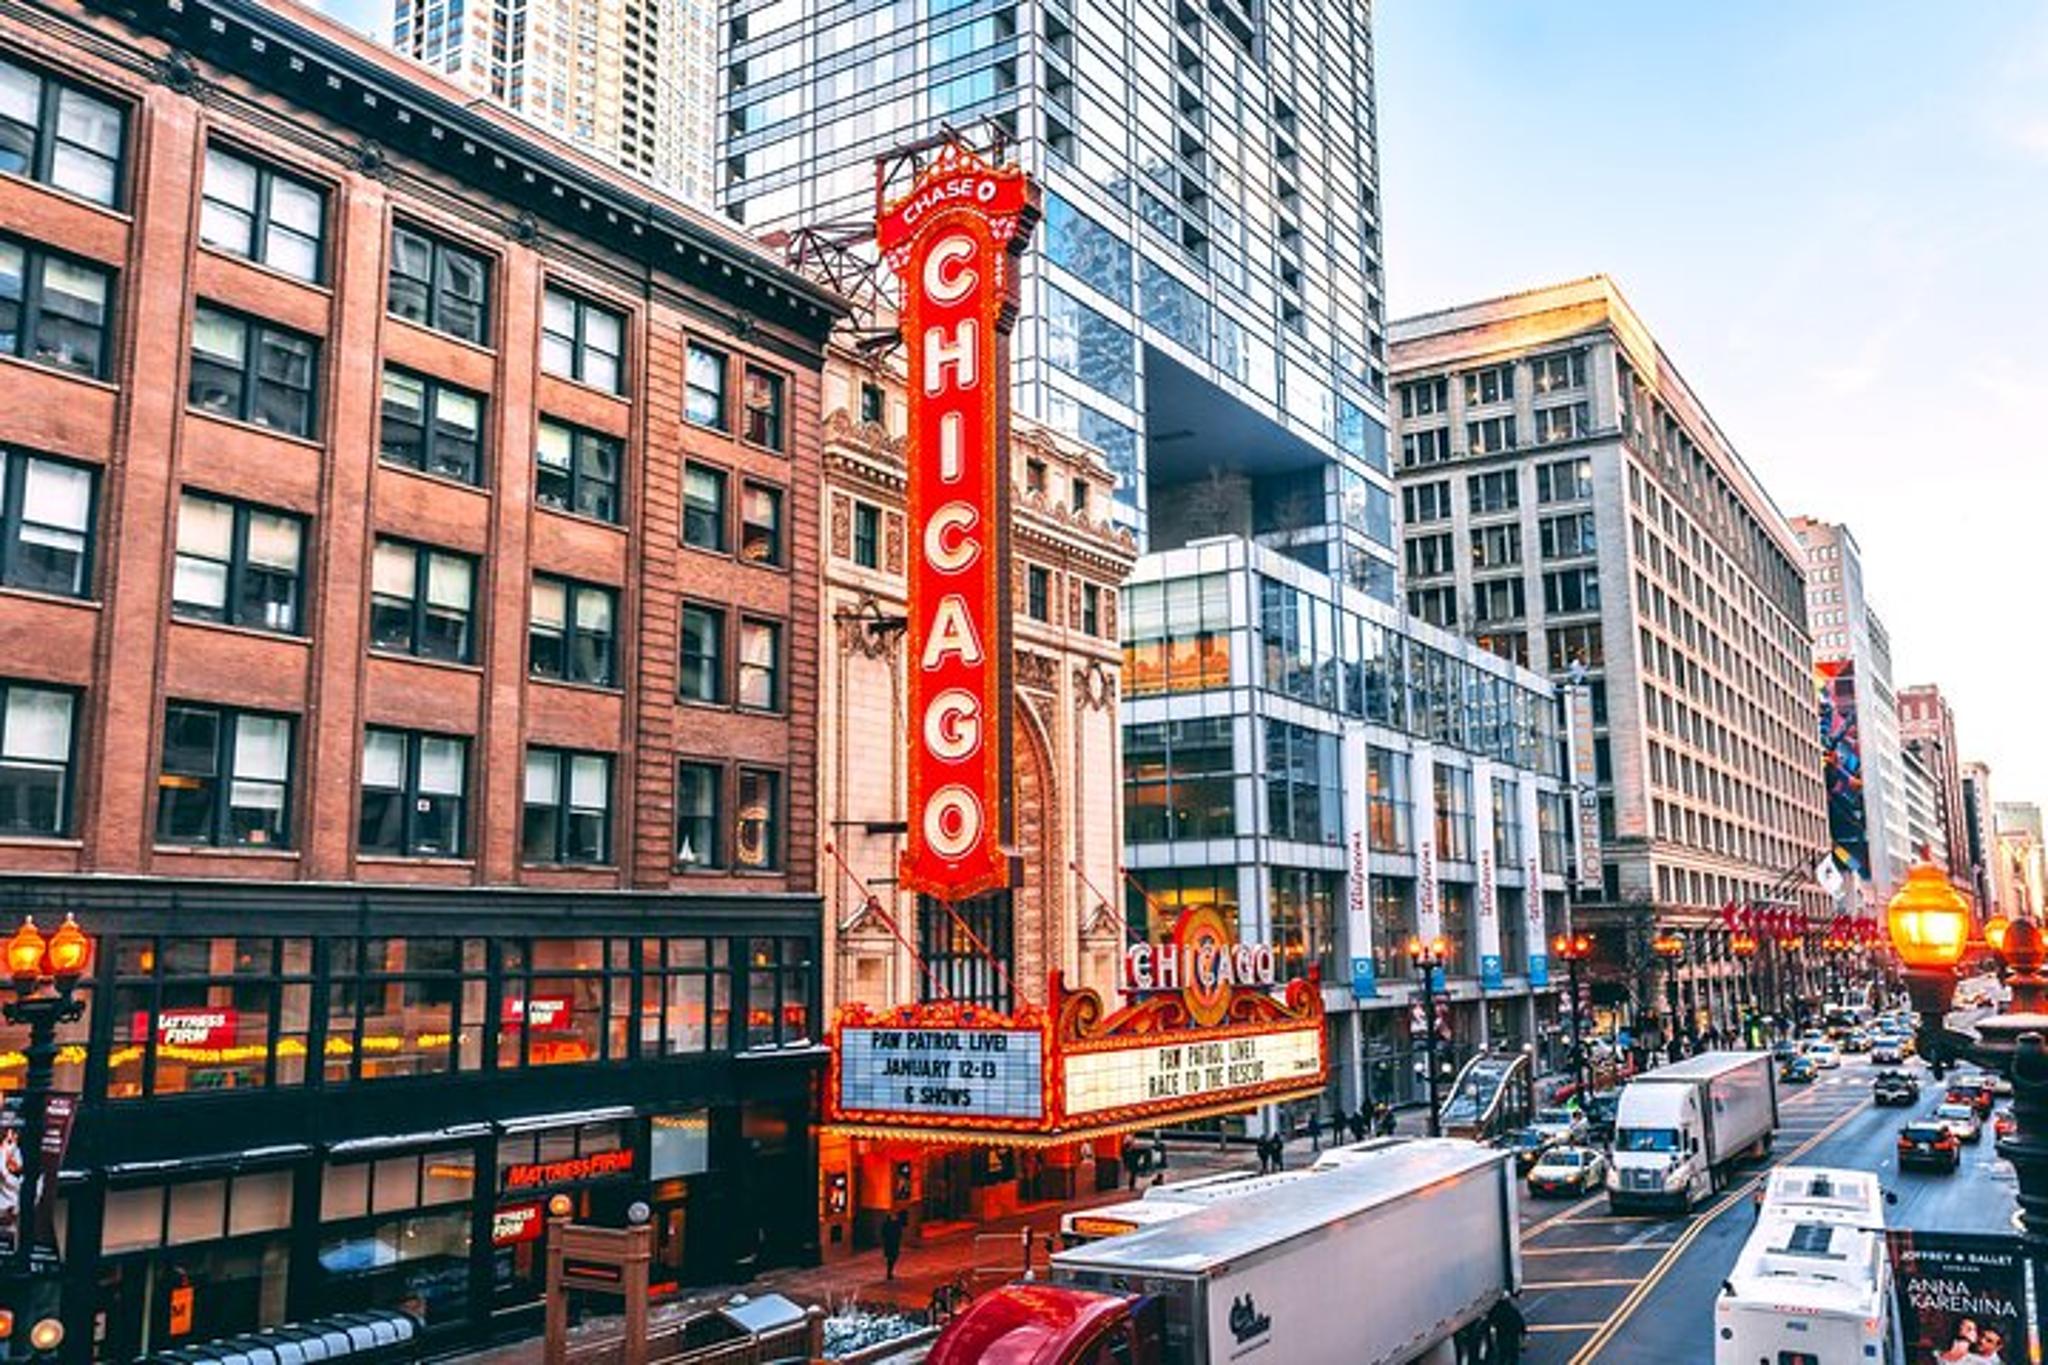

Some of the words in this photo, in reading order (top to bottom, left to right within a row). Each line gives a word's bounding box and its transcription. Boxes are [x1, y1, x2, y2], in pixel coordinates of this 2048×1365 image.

[902, 179, 974, 225] CHASE
[922, 234, 982, 861] CHICAGO
[1129, 943, 1275, 989] CHICAGO
[164, 1029, 209, 1044] FIRM
[872, 1032, 901, 1051] PAW
[907, 1032, 962, 1051] PATROL
[970, 1034, 1007, 1052] LIVE!
[1159, 1048, 1181, 1072] PAW
[1188, 1043, 1224, 1067] PATROL
[1229, 1039, 1256, 1061] LIVE!
[882, 1059, 950, 1078] JANUARY
[959, 1060, 996, 1079] 12-13
[1149, 1072, 1179, 1098] RACE
[1186, 1069, 1200, 1092] TO
[1205, 1066, 1224, 1089] THE
[1228, 1060, 1264, 1085] RESCUE
[905, 1086, 914, 1104] 6
[921, 1087, 971, 1107] SHOWS
[1901, 1250, 1952, 1262] JOFFREY
[1968, 1254, 2012, 1266] BALLET
[1907, 1278, 1972, 1298] ANNA
[1909, 1293, 2019, 1319] KARENINA
